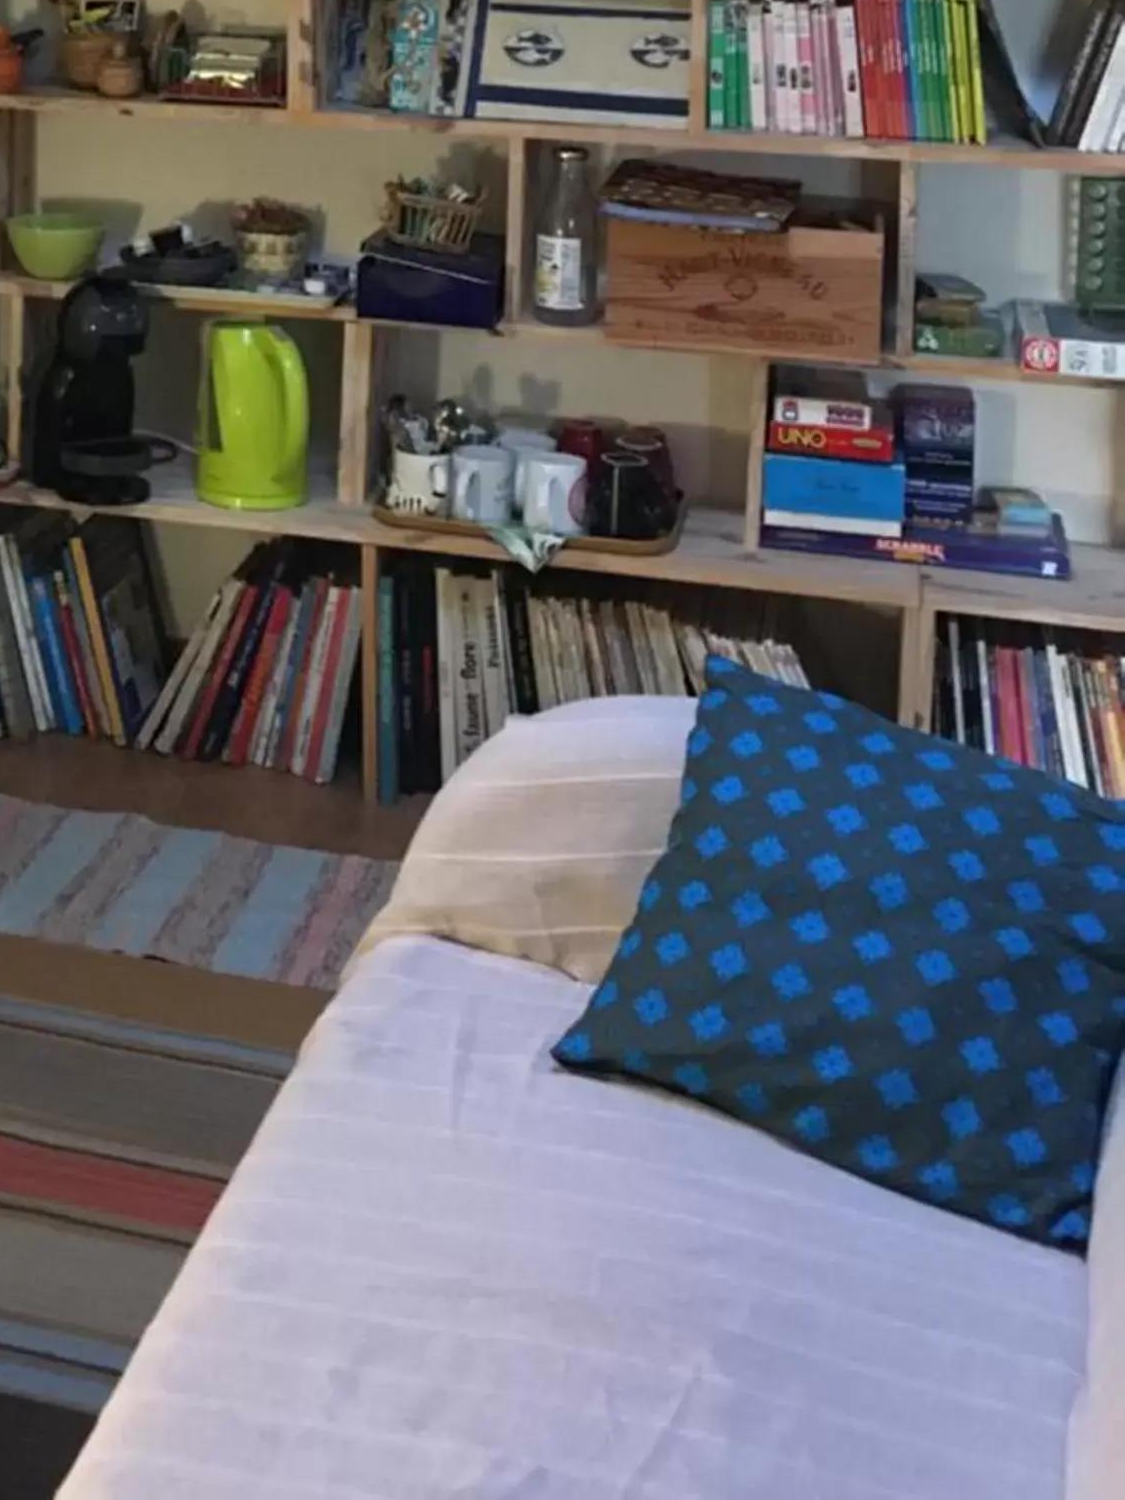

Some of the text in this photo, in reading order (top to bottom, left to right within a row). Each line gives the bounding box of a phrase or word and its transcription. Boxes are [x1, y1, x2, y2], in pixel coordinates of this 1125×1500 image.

[777, 426, 827, 449] UNO
[876, 538, 946, 562] SCRABBLE
[460, 640, 479, 680] flore
